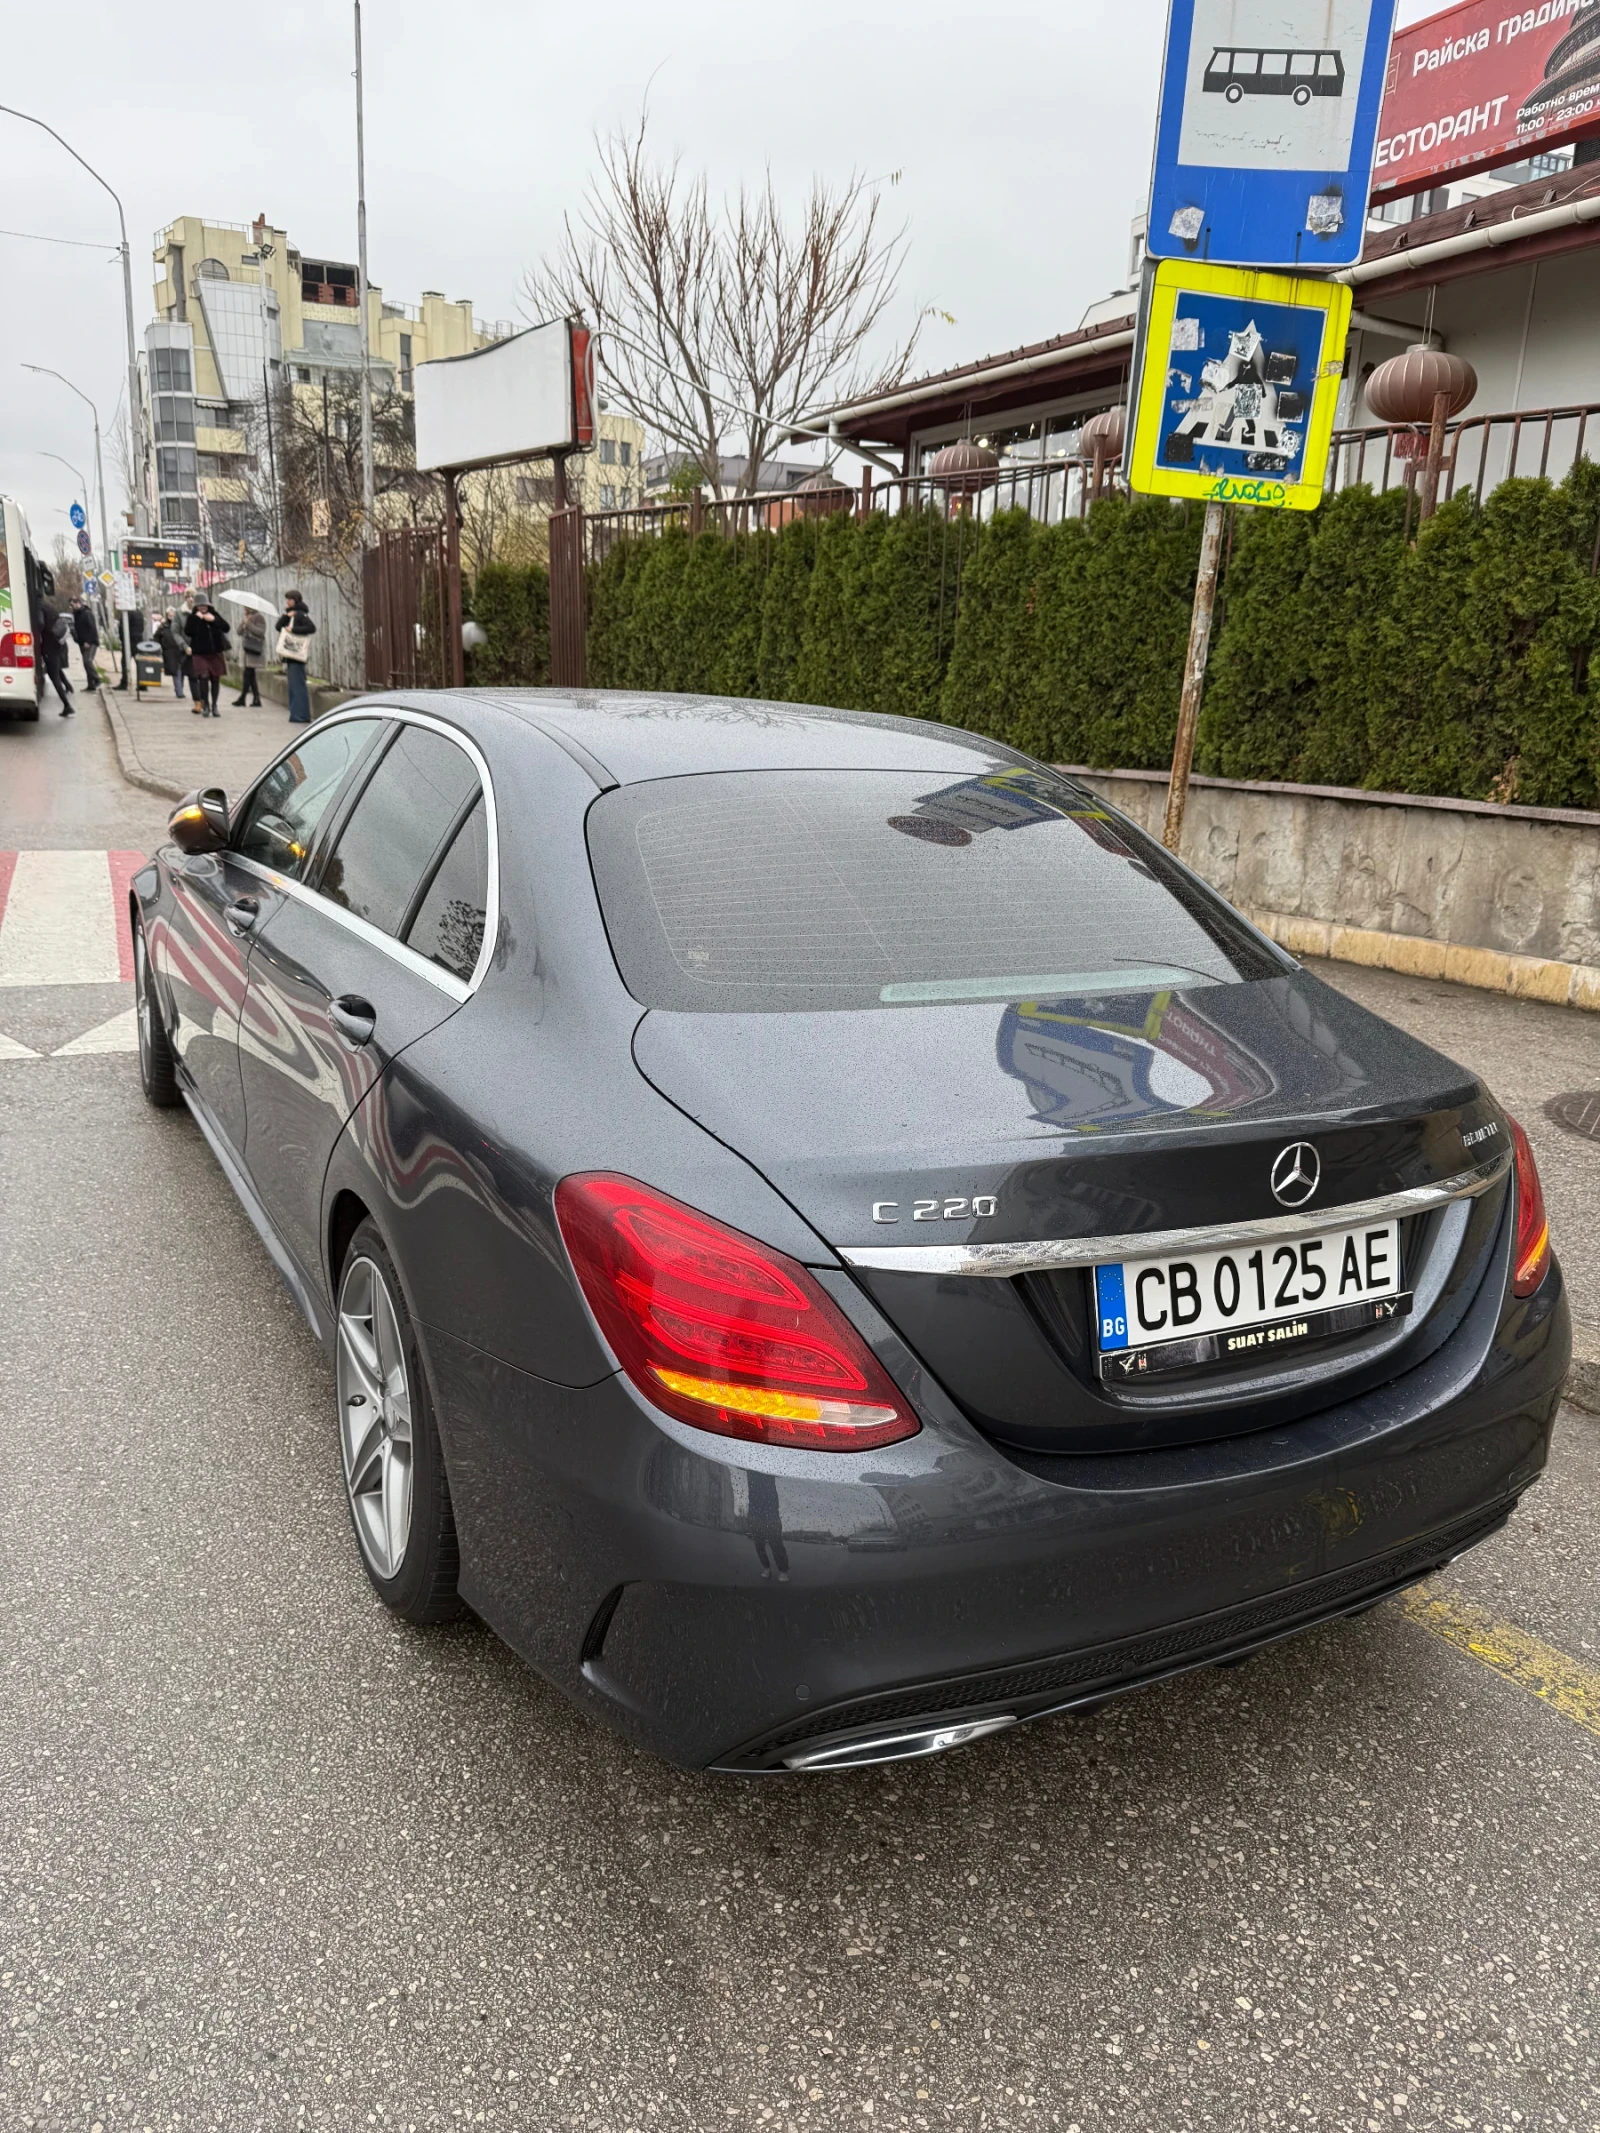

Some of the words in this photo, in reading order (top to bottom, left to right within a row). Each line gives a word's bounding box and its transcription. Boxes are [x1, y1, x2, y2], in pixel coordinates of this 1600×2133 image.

[1412, 28, 1490, 77] Райска
[1515, 95, 1565, 120] Работно
[1568, 83, 1600, 101] врем
[1516, 116, 1545, 135] 11:00
[1556, 100, 1594, 122] 23:00
[1375, 95, 1509, 168] ЕСТОРАНТ
[872, 1202, 899, 1224] C
[913, 1195, 998, 1221] 220
[1135, 1262, 1202, 1331] CB
[1213, 1241, 1327, 1317] 0125
[1338, 1229, 1391, 1295] AE
[1102, 1317, 1126, 1338] BG
[1227, 1332, 1265, 1351] SUAT
[1267, 1320, 1308, 1342] SALİH
